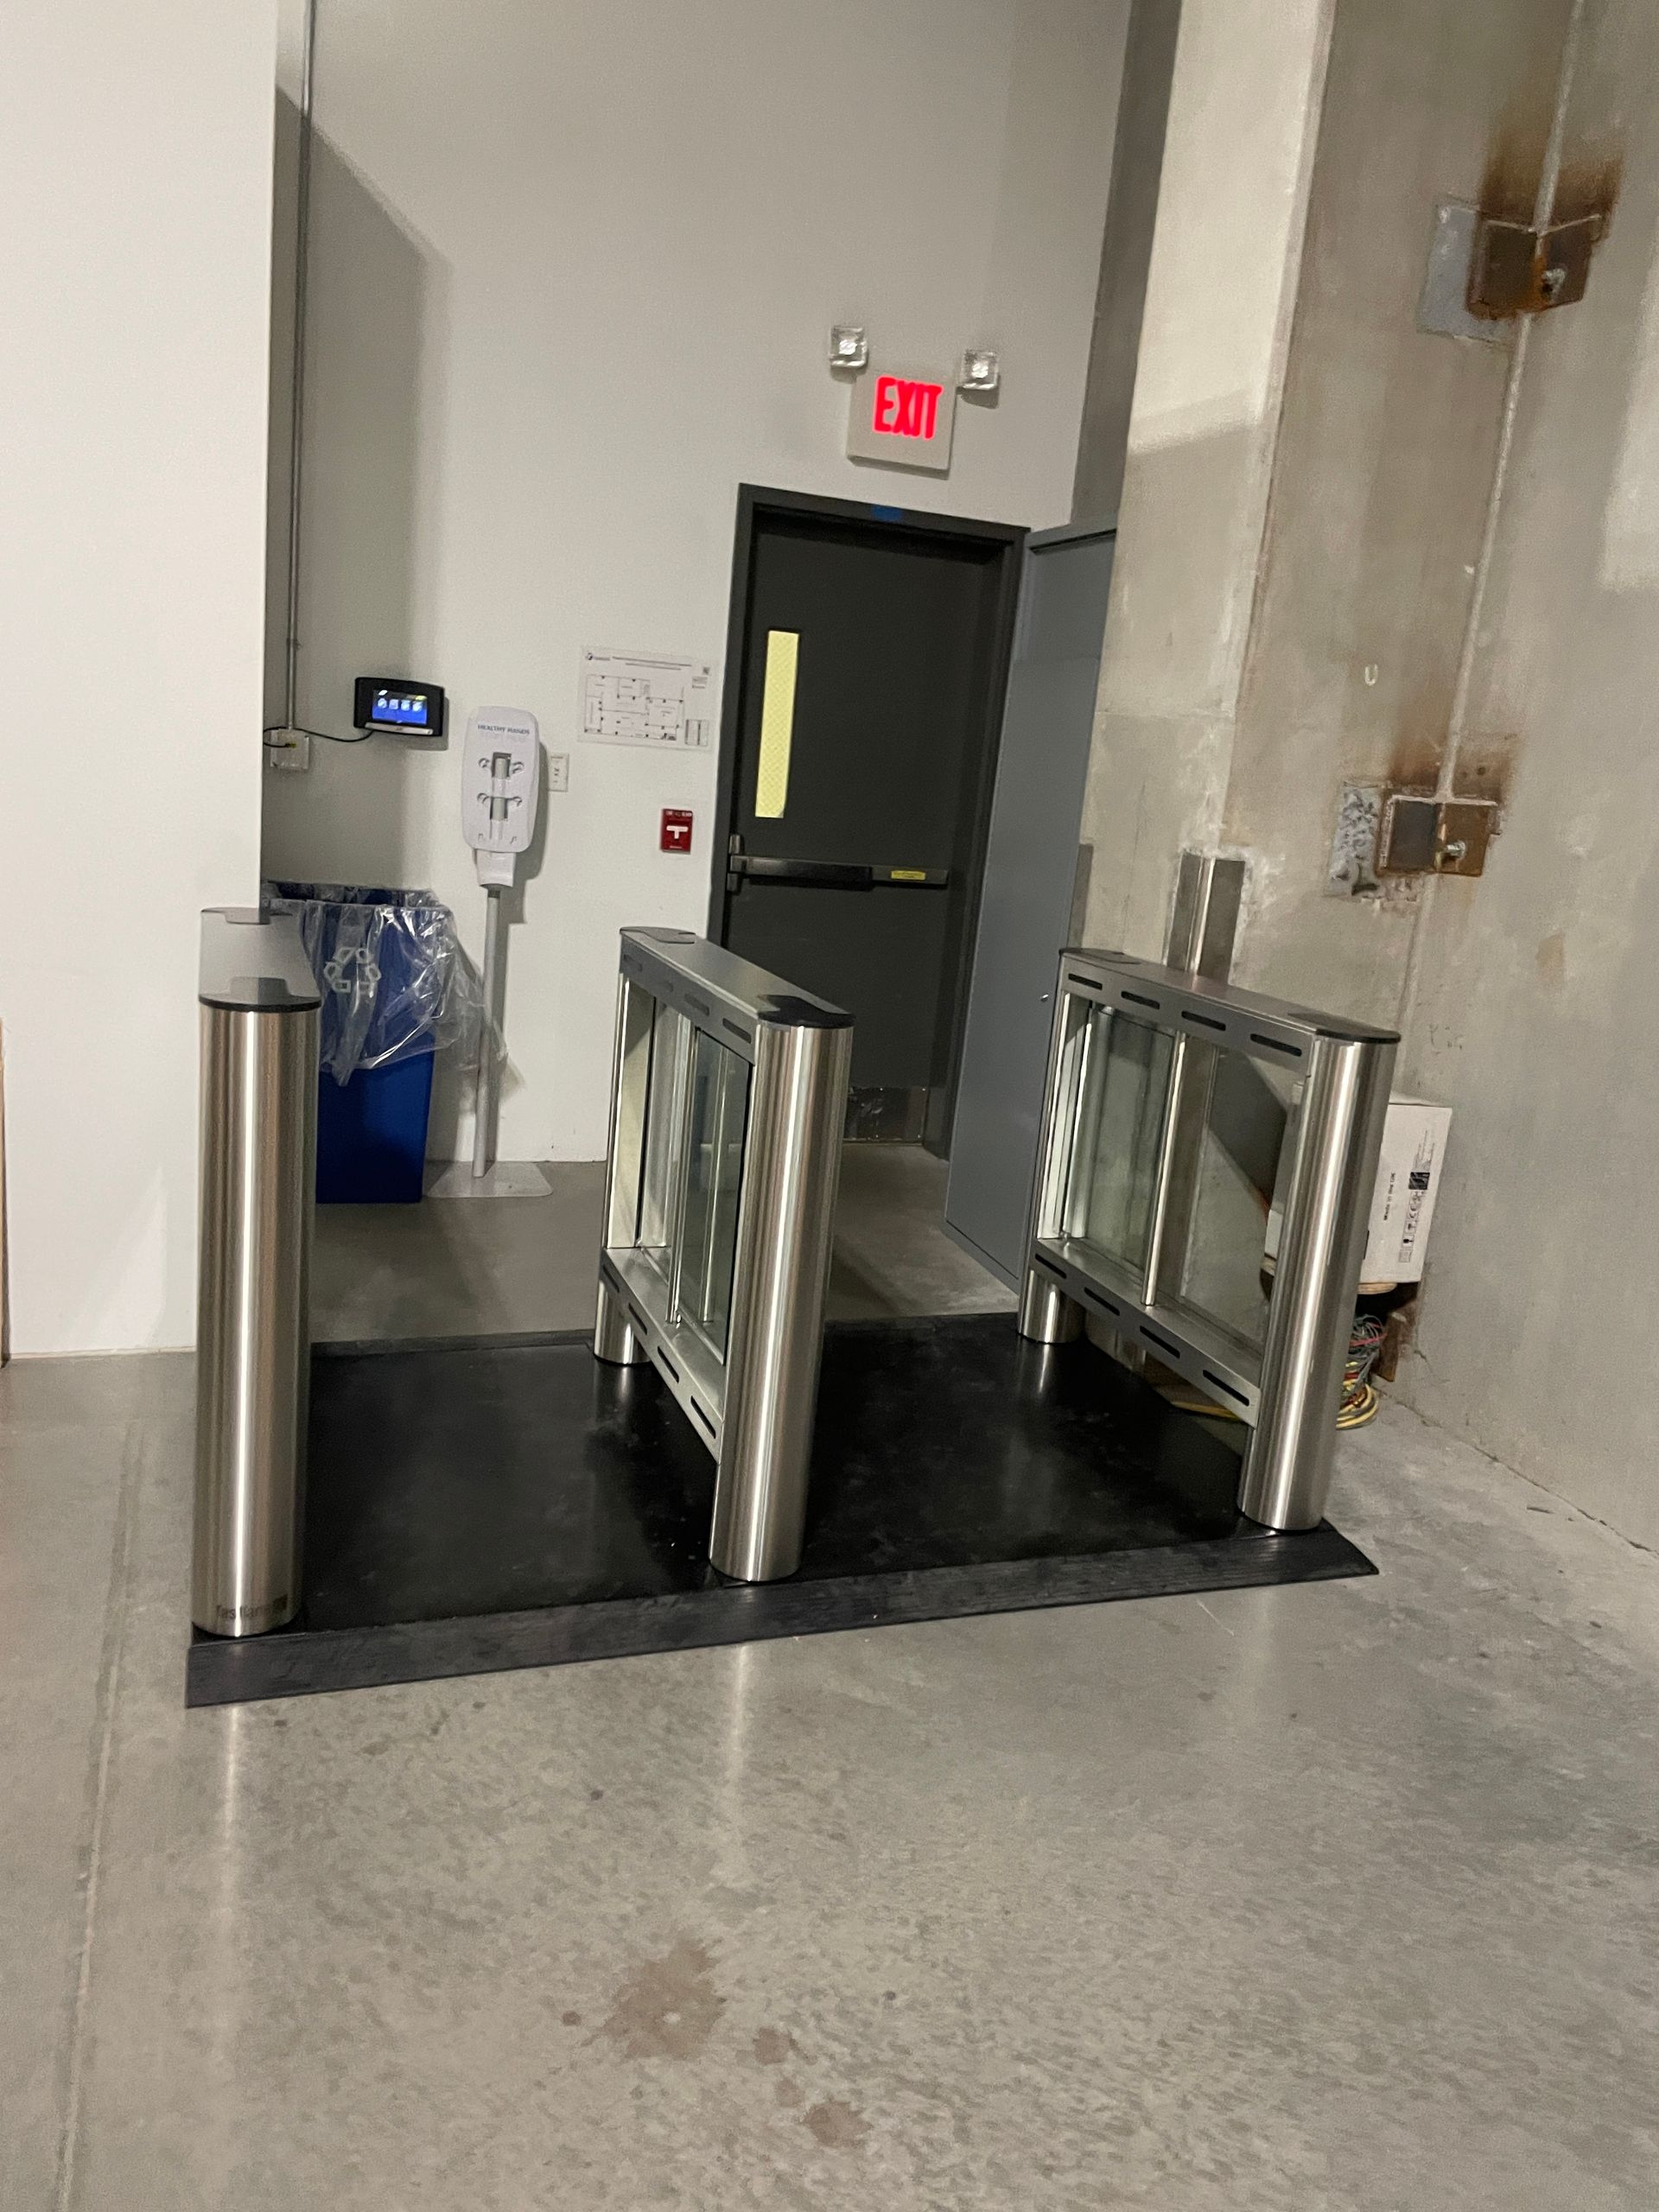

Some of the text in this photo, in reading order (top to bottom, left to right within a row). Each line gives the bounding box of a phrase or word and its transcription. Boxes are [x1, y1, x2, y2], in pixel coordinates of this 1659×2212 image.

[873, 375, 944, 440] EXIT
[477, 724, 506, 733] HEALTHY
[216, 1604, 271, 1620] faslan
